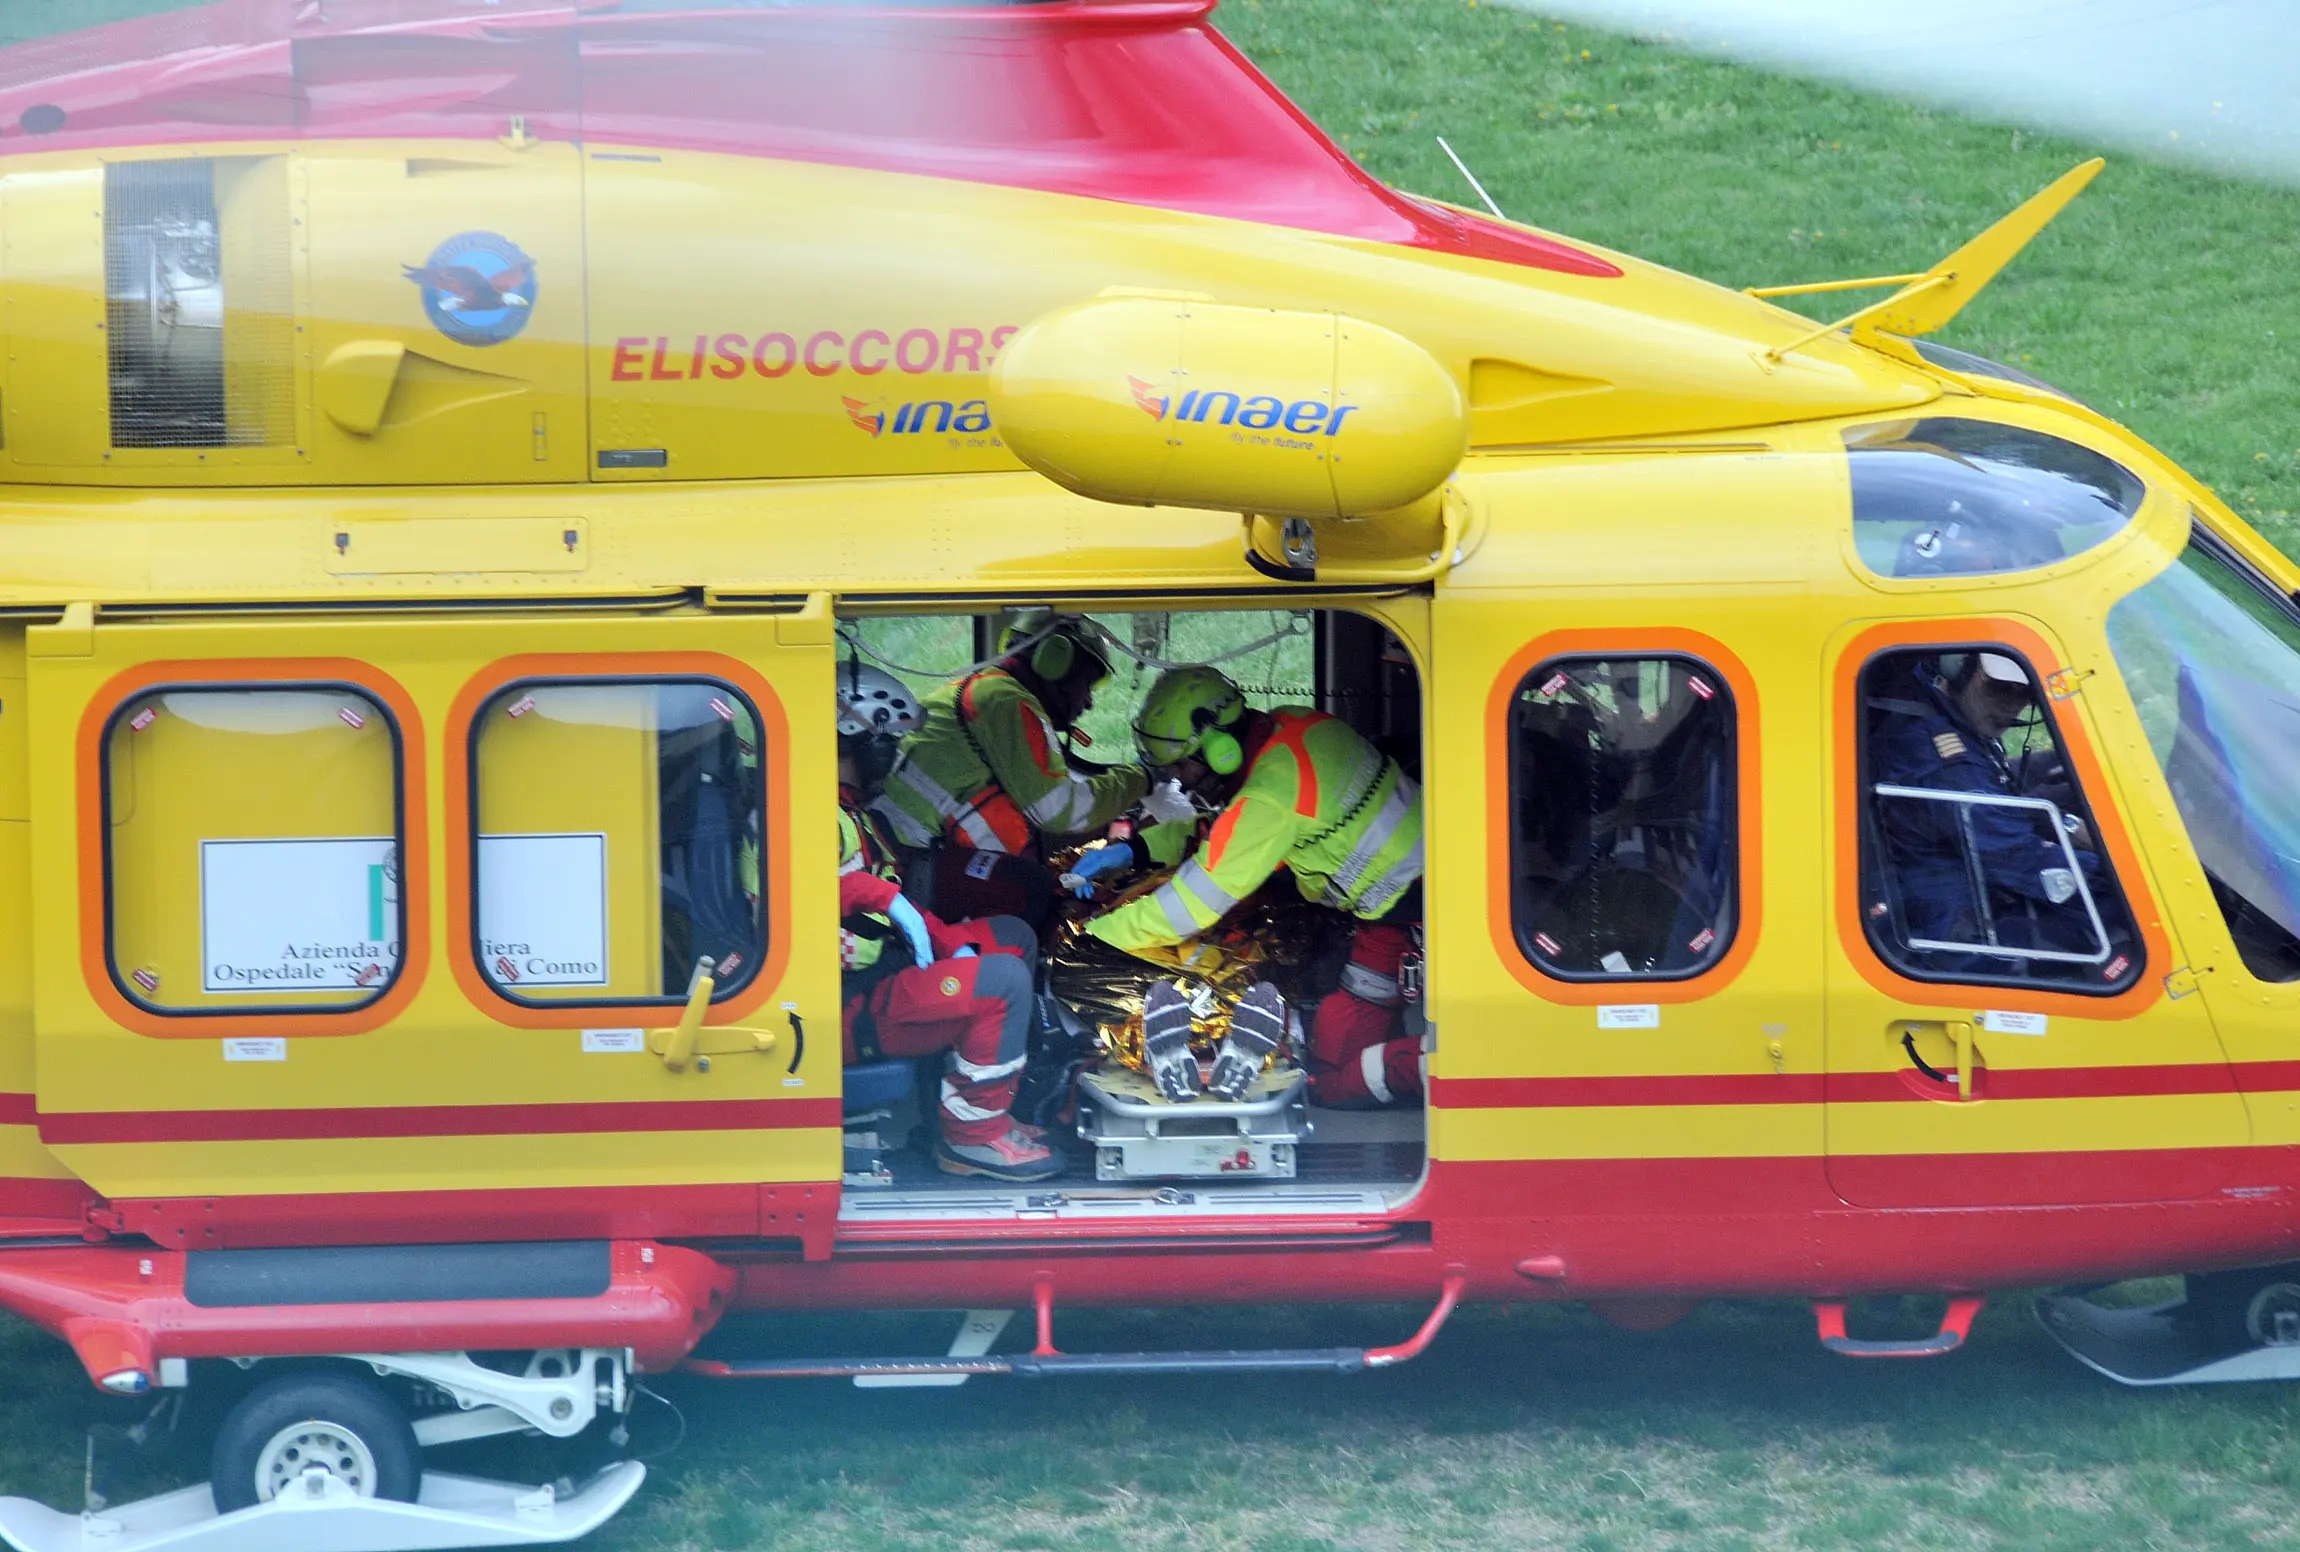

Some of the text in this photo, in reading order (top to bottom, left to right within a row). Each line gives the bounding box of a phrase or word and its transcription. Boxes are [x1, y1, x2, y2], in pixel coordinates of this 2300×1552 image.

[1176, 390, 1359, 437] inaer
[281, 941, 380, 959] Azienda
[214, 962, 326, 983] Ospedale
[526, 958, 598, 975] Como
